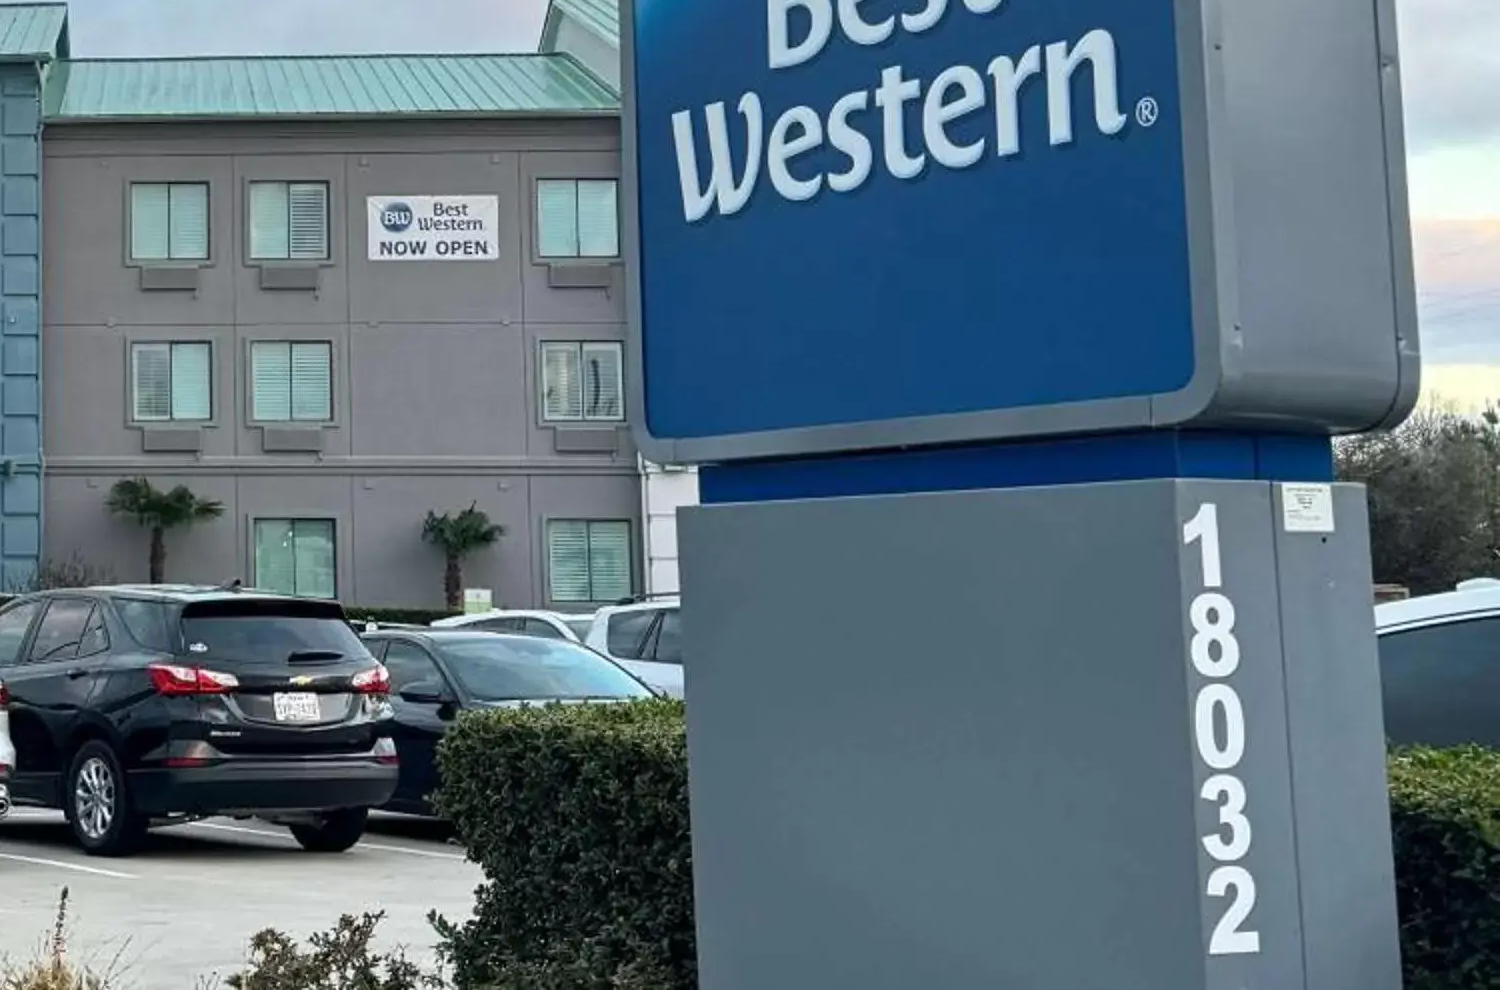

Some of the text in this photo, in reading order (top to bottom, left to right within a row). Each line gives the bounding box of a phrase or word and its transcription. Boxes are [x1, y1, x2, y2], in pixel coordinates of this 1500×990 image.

[670, 29, 1127, 222] Western
[433, 202, 469, 217] Best
[383, 210, 411, 225] BW
[417, 217, 483, 231] Western
[379, 241, 427, 256] NOW
[435, 241, 489, 256] OPEN
[1183, 503, 1260, 955] 18032
